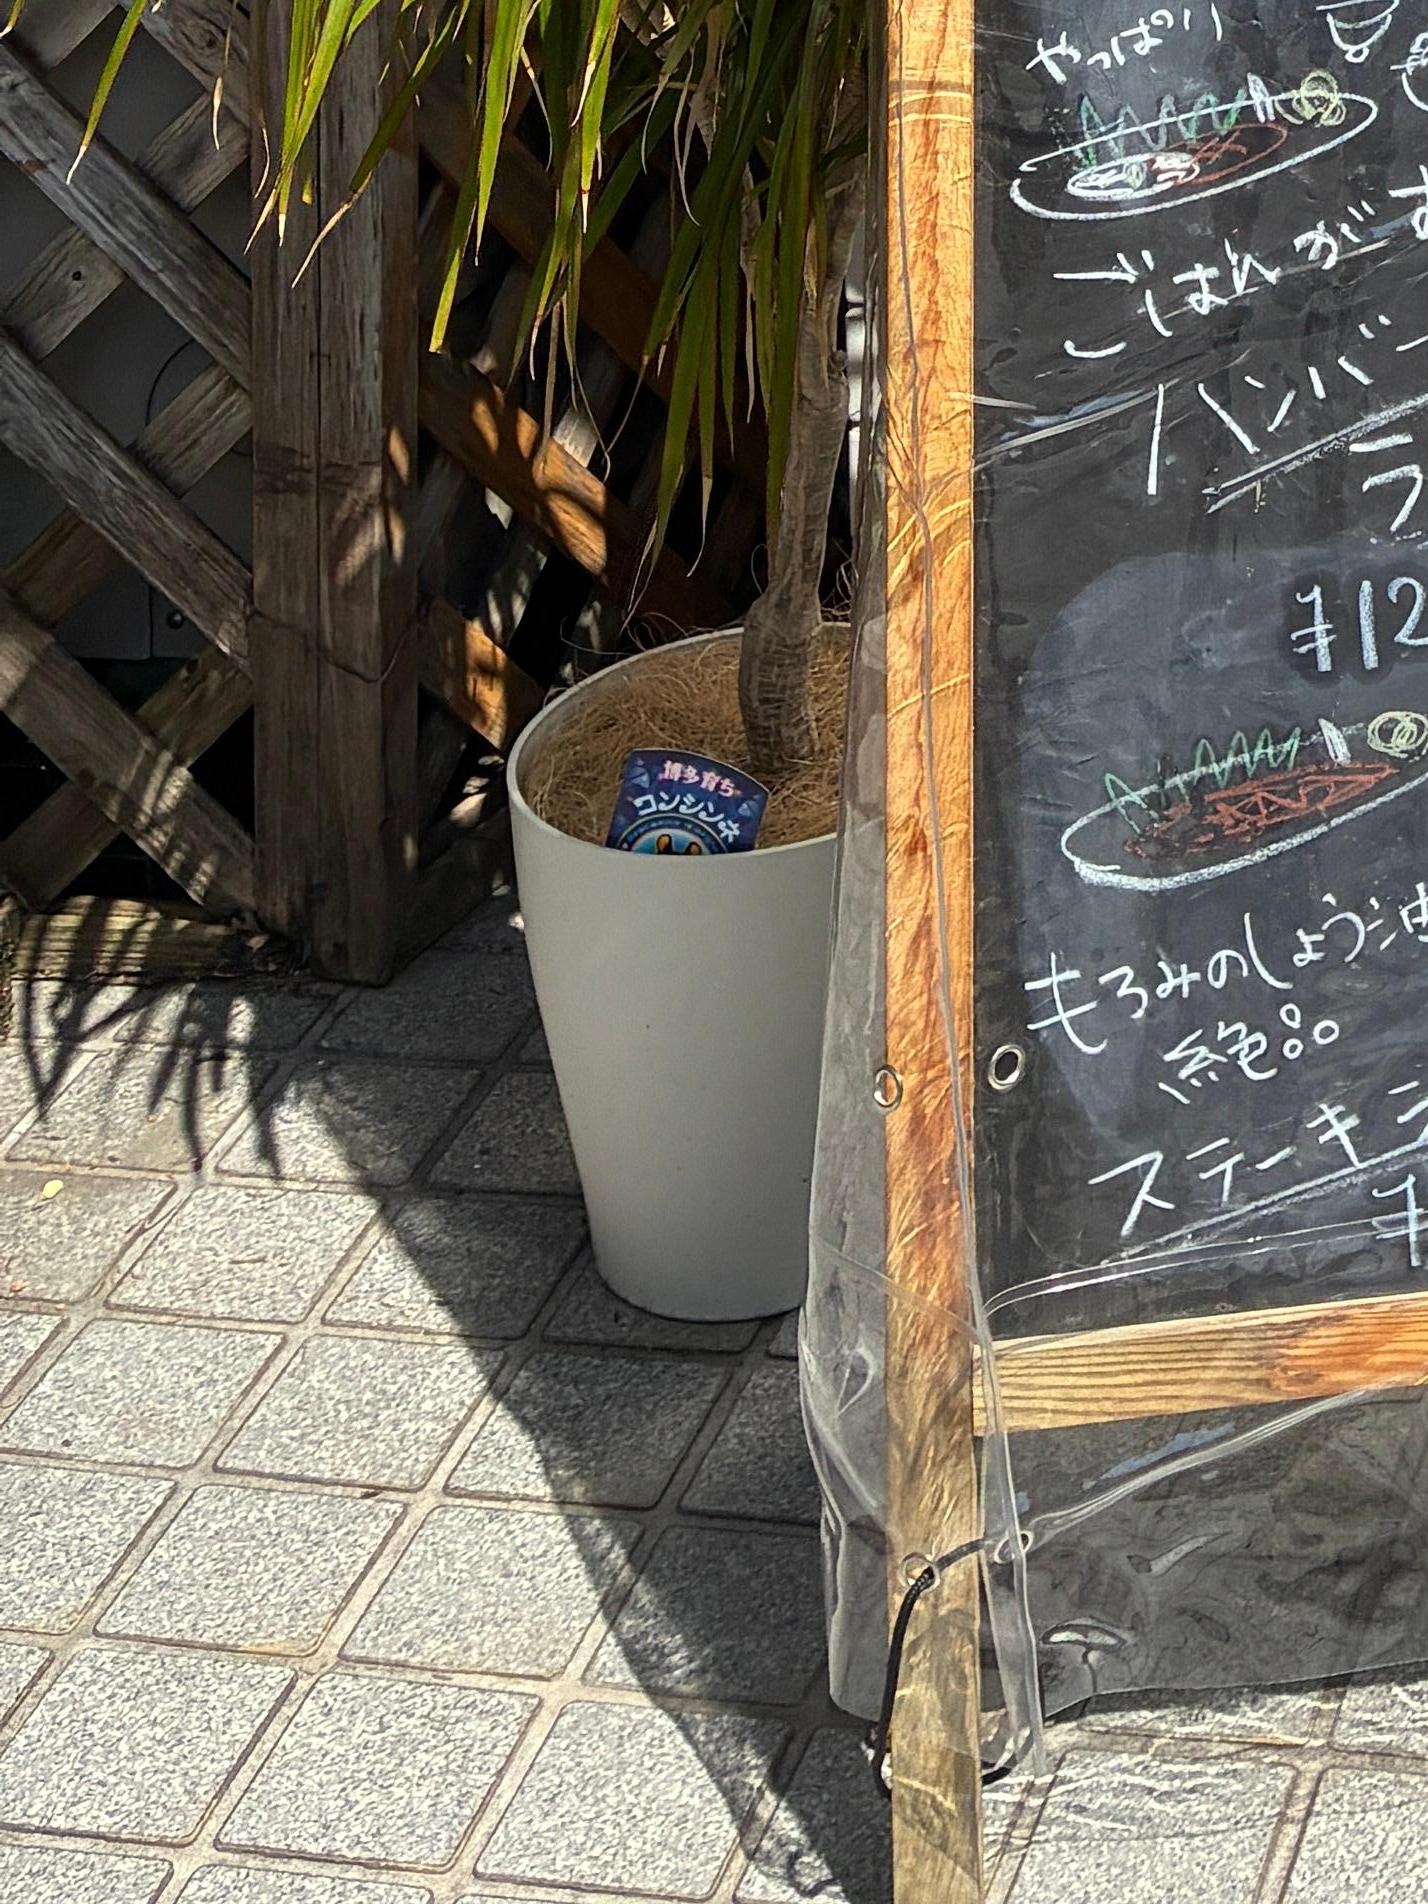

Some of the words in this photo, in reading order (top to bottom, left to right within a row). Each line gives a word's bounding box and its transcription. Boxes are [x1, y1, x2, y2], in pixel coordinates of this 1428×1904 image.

[1025, 2, 1222, 84] やっぱり
[1158, 1002, 1340, 1104] 絶品
